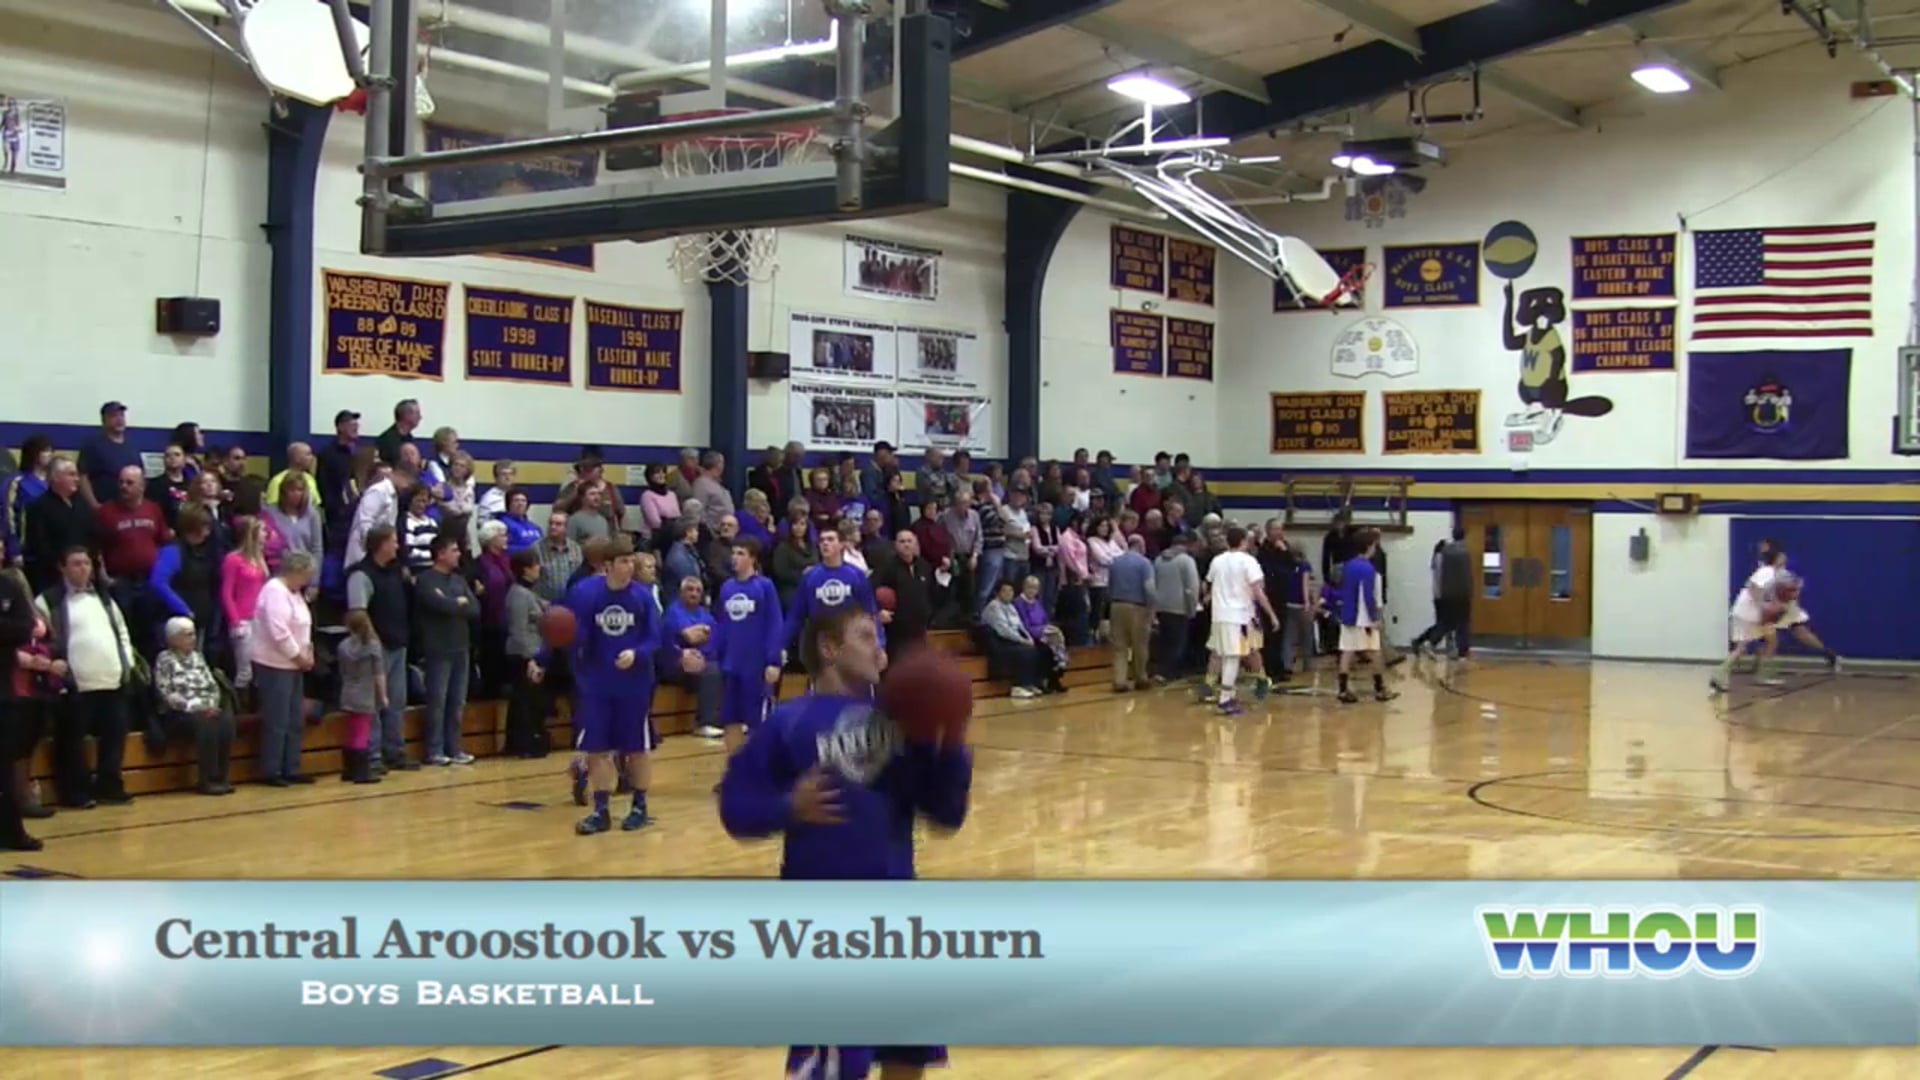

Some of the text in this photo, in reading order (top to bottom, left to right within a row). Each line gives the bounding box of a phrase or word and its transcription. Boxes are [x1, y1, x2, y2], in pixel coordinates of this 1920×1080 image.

[1584, 240, 1609, 252] BOYS
[1617, 239, 1649, 251] CLASS
[1592, 252, 1654, 267] BASKETBALL
[1583, 267, 1665, 281] EASTERN MAINE
[327, 275, 402, 299] WASHBURN
[1596, 281, 1650, 294] RUNNER-UP
[327, 292, 446, 320] CHEERING CLASS D
[467, 296, 528, 319] CHEERLEADING
[533, 304, 560, 323] CLASS
[588, 306, 636, 328] BASEBALL
[642, 313, 671, 330] CLASS
[1586, 313, 1611, 325] BOYS
[1617, 311, 1649, 324] CLASS
[357, 316, 417, 337] 88 89
[1592, 325, 1653, 339] BASKETBALL
[503, 326, 536, 345] 1998
[621, 330, 648, 348] 1991
[336, 336, 435, 360] STATE OF MAINE
[1574, 339, 1672, 354] AROOSTOOK LEAGUE
[349, 352, 422, 371] RUNNER-UP
[472, 349, 565, 373] STATE RUNNER-UP
[597, 346, 672, 368] EASTERN MAINE
[1523, 350, 1539, 371] W
[1595, 354, 1650, 367] CHAMPIONS
[610, 367, 659, 385] RUNNER-UP
[1278, 408, 1357, 419] BOYS CLASS D
[1388, 403, 1473, 416] BOYS CLASS D
[1388, 429, 1473, 441] EASTERN MAINE
[1277, 438, 1358, 449] STATE CHAMPS
[1408, 439, 1453, 449] CHAMPS
